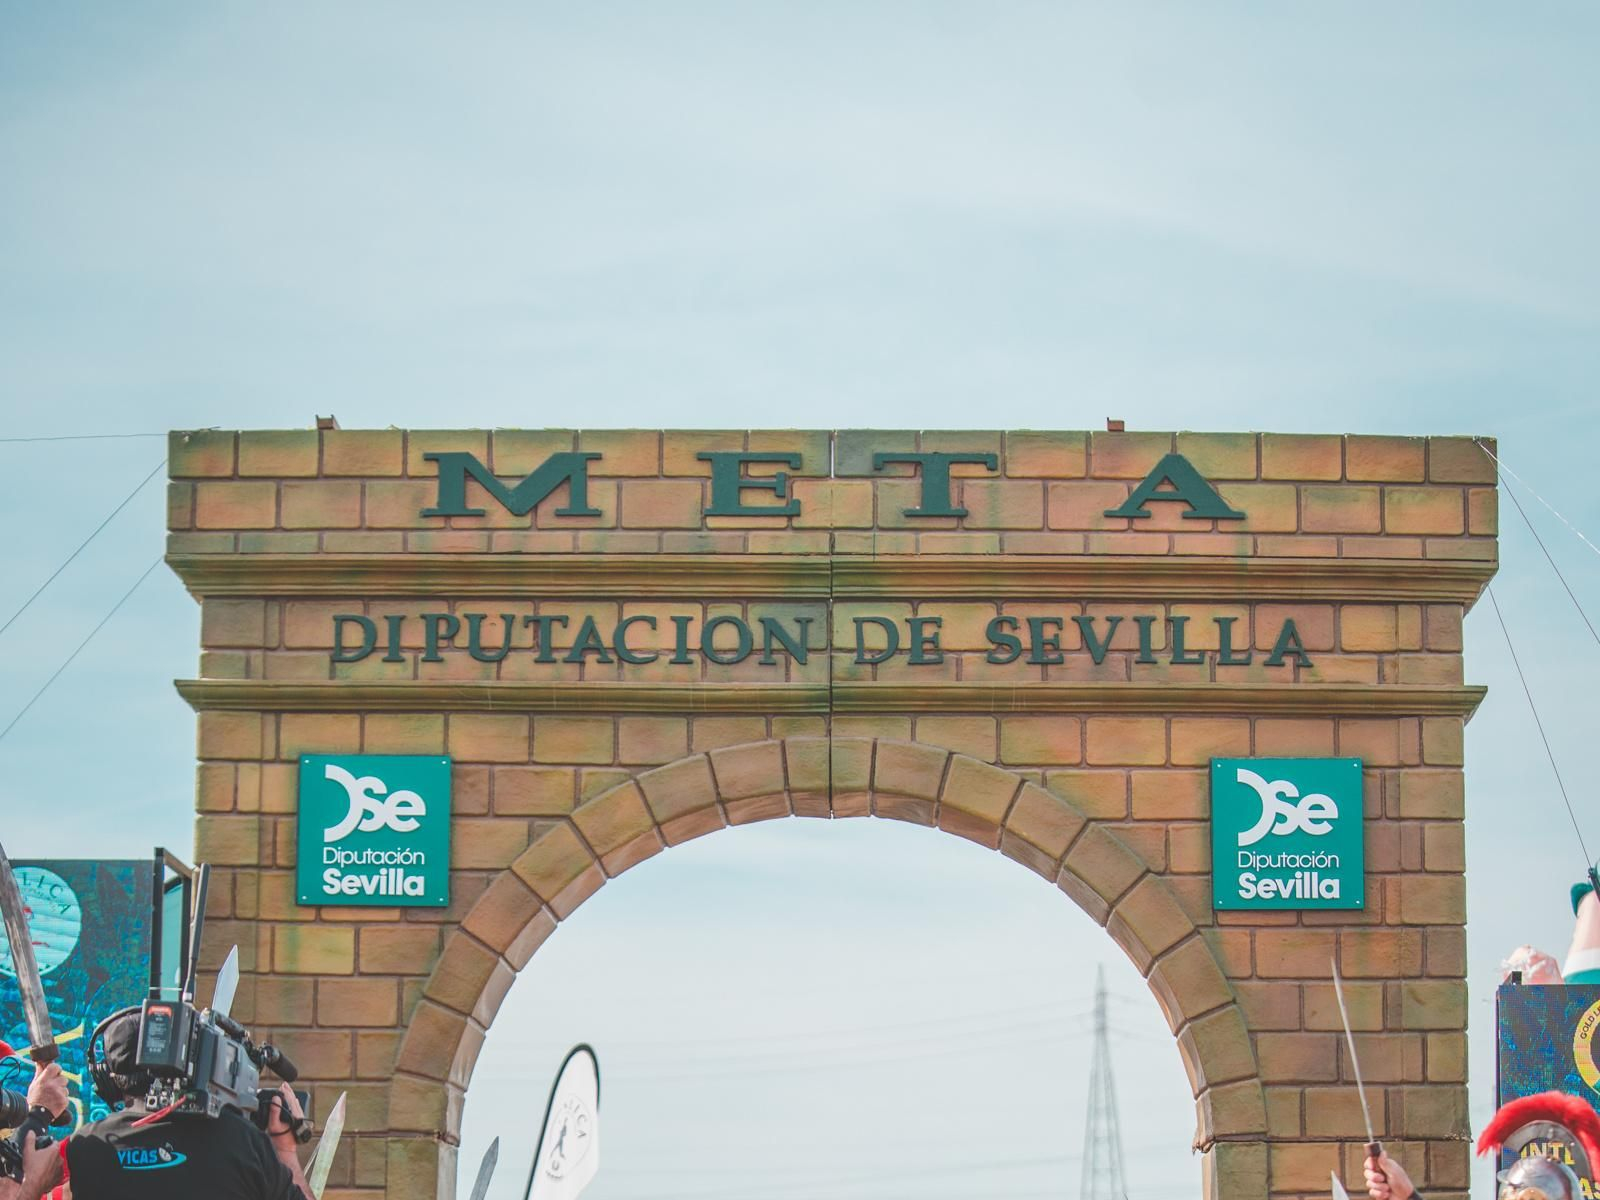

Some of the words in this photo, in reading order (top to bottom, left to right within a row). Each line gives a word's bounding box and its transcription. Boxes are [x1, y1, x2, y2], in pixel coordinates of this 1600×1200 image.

[420, 452, 1246, 519] META
[331, 613, 813, 665] DIPUTACION
[852, 616, 944, 665] DE
[985, 615, 1313, 668] SEVILLA
[323, 846, 425, 868] Diputación
[1238, 851, 1340, 871] Diputación
[21, 872, 72, 915] LICA
[323, 868, 425, 896] Sevilla
[1239, 871, 1340, 899] Sevilla
[1580, 1015, 1595, 1040] GOLD
